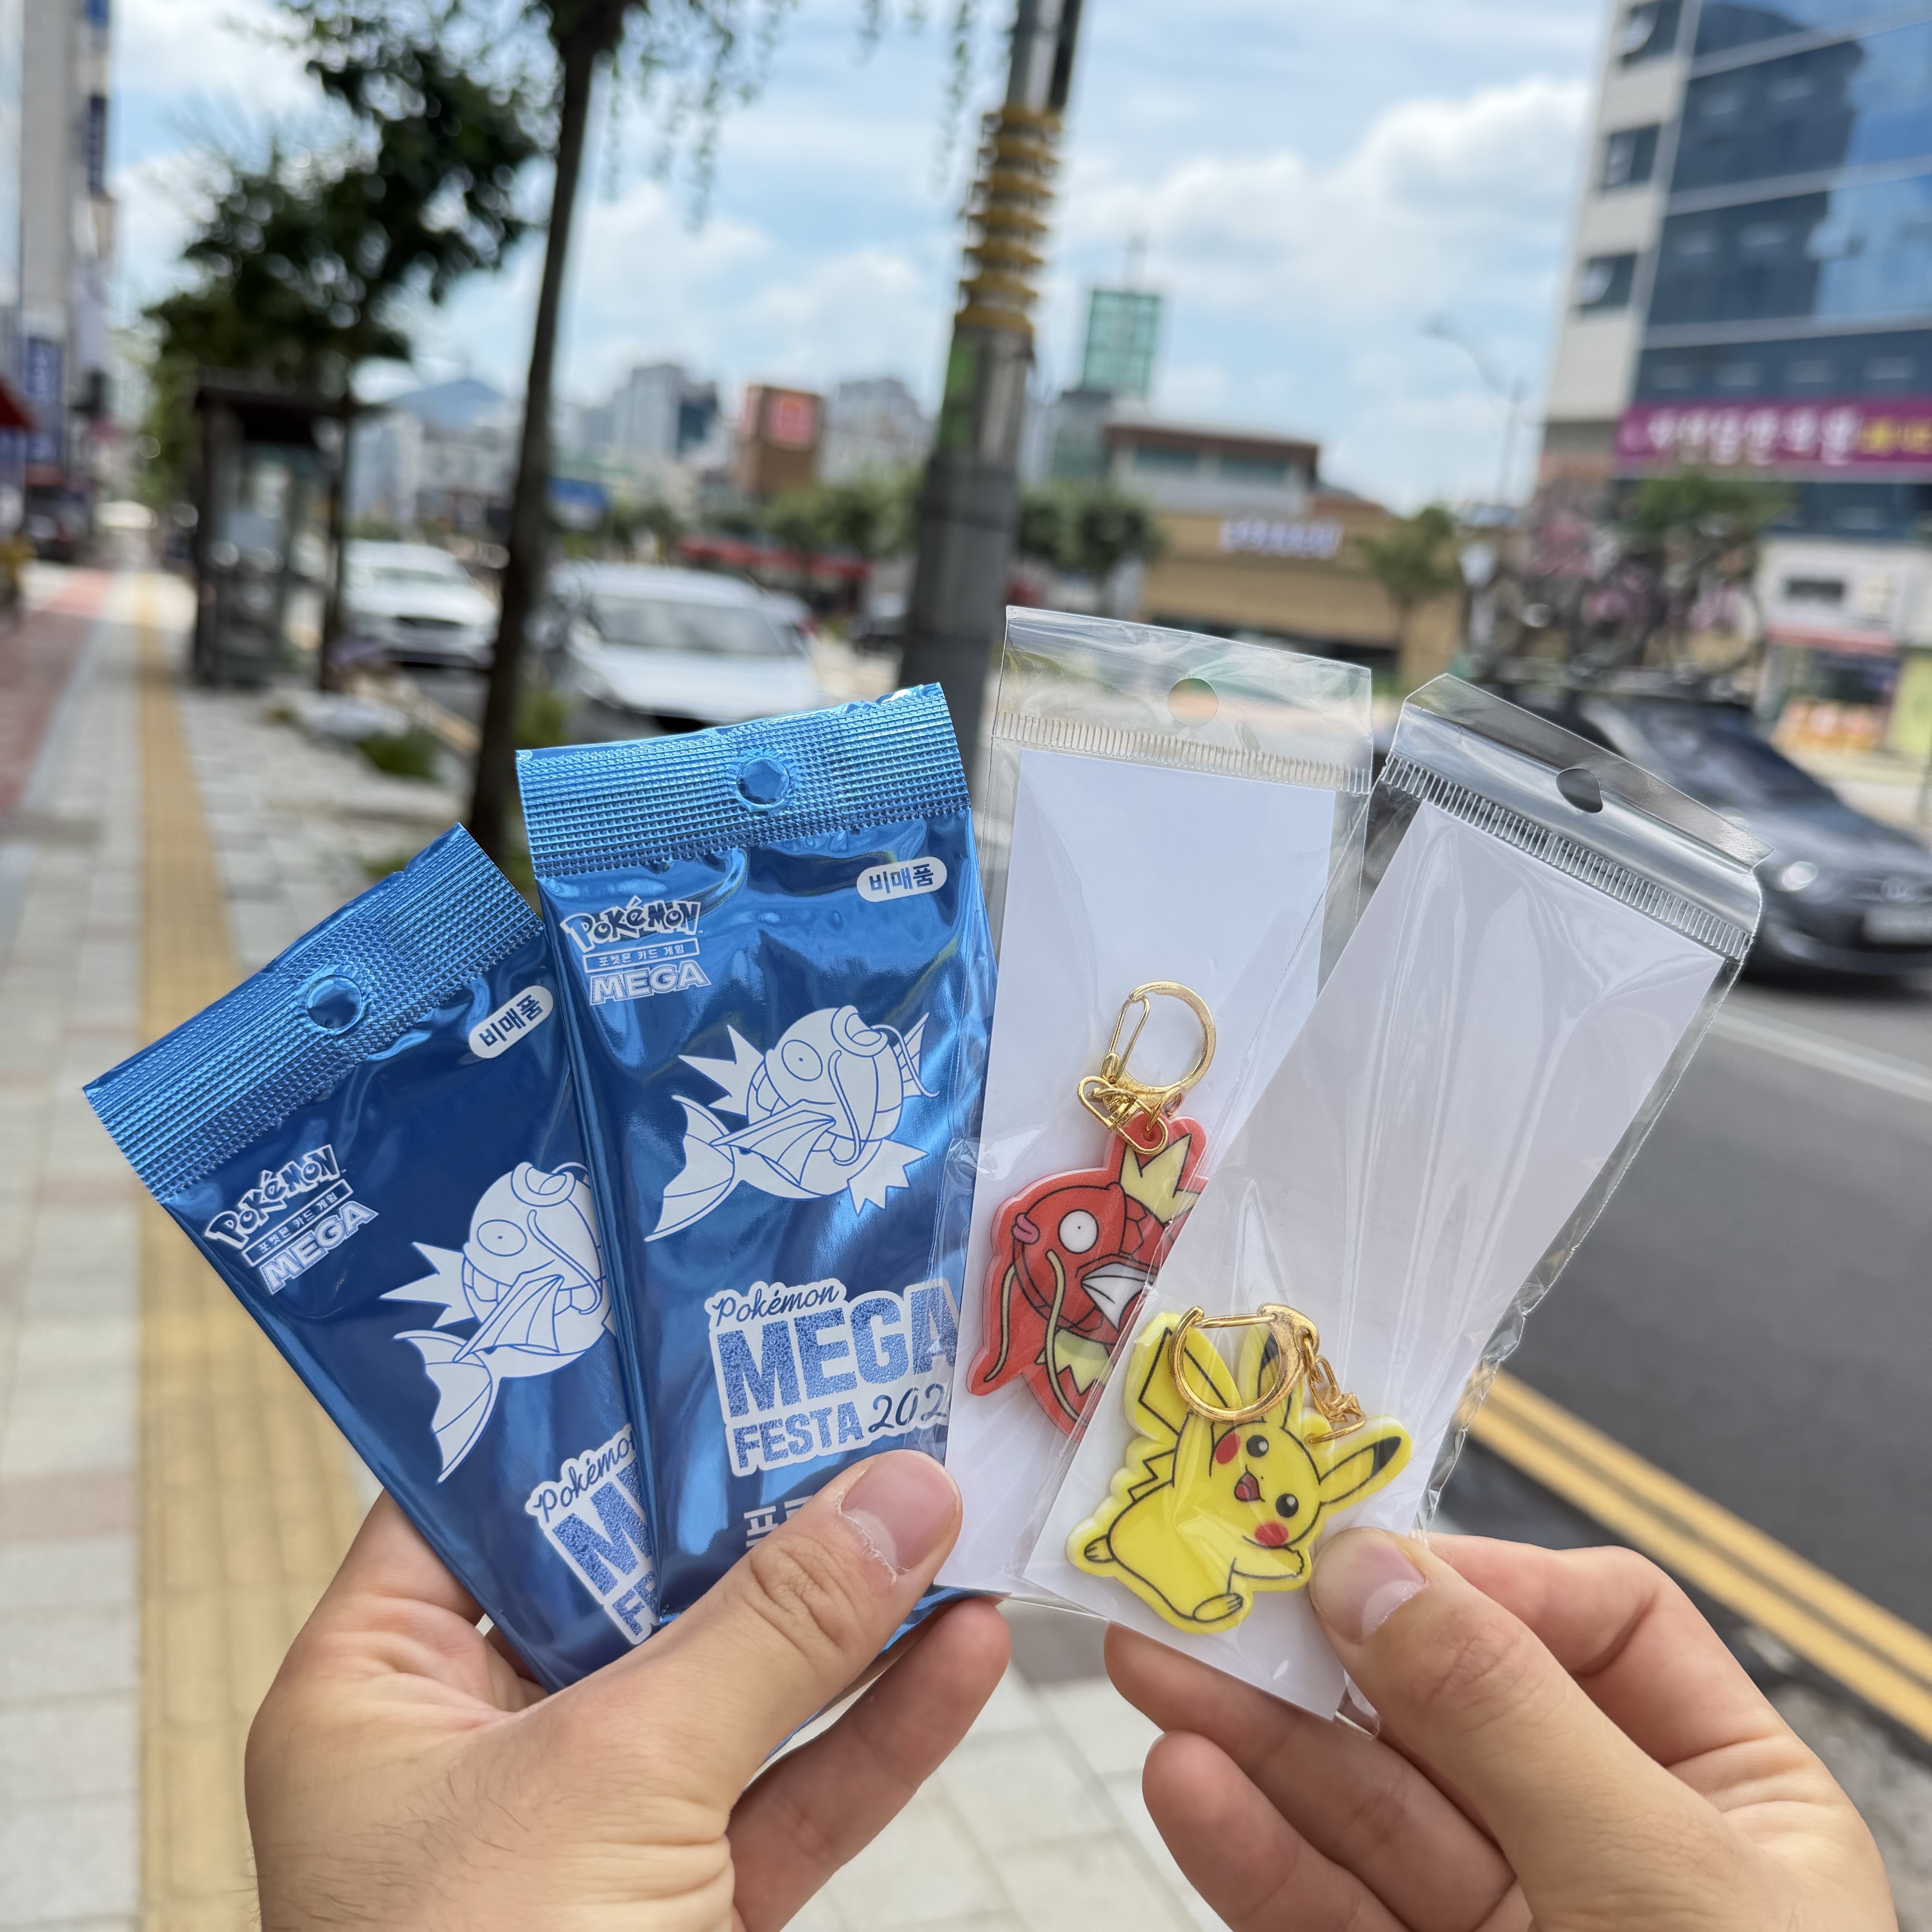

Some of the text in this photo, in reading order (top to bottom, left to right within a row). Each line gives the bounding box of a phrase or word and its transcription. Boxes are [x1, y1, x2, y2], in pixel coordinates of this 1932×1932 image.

[869, 864, 934, 894] 비매품
[599, 944, 684, 967] 포켓몬 카드 게임
[590, 959, 711, 1005] MEGA
[479, 995, 543, 1046] 비매품
[257, 1192, 338, 1253] 포켓몬 카드 게임
[259, 1200, 379, 1295] MEGA
[712, 1284, 840, 1327] Pokémon
[717, 1286, 959, 1418] MEGA
[733, 1383, 951, 1469] FESTA 202
